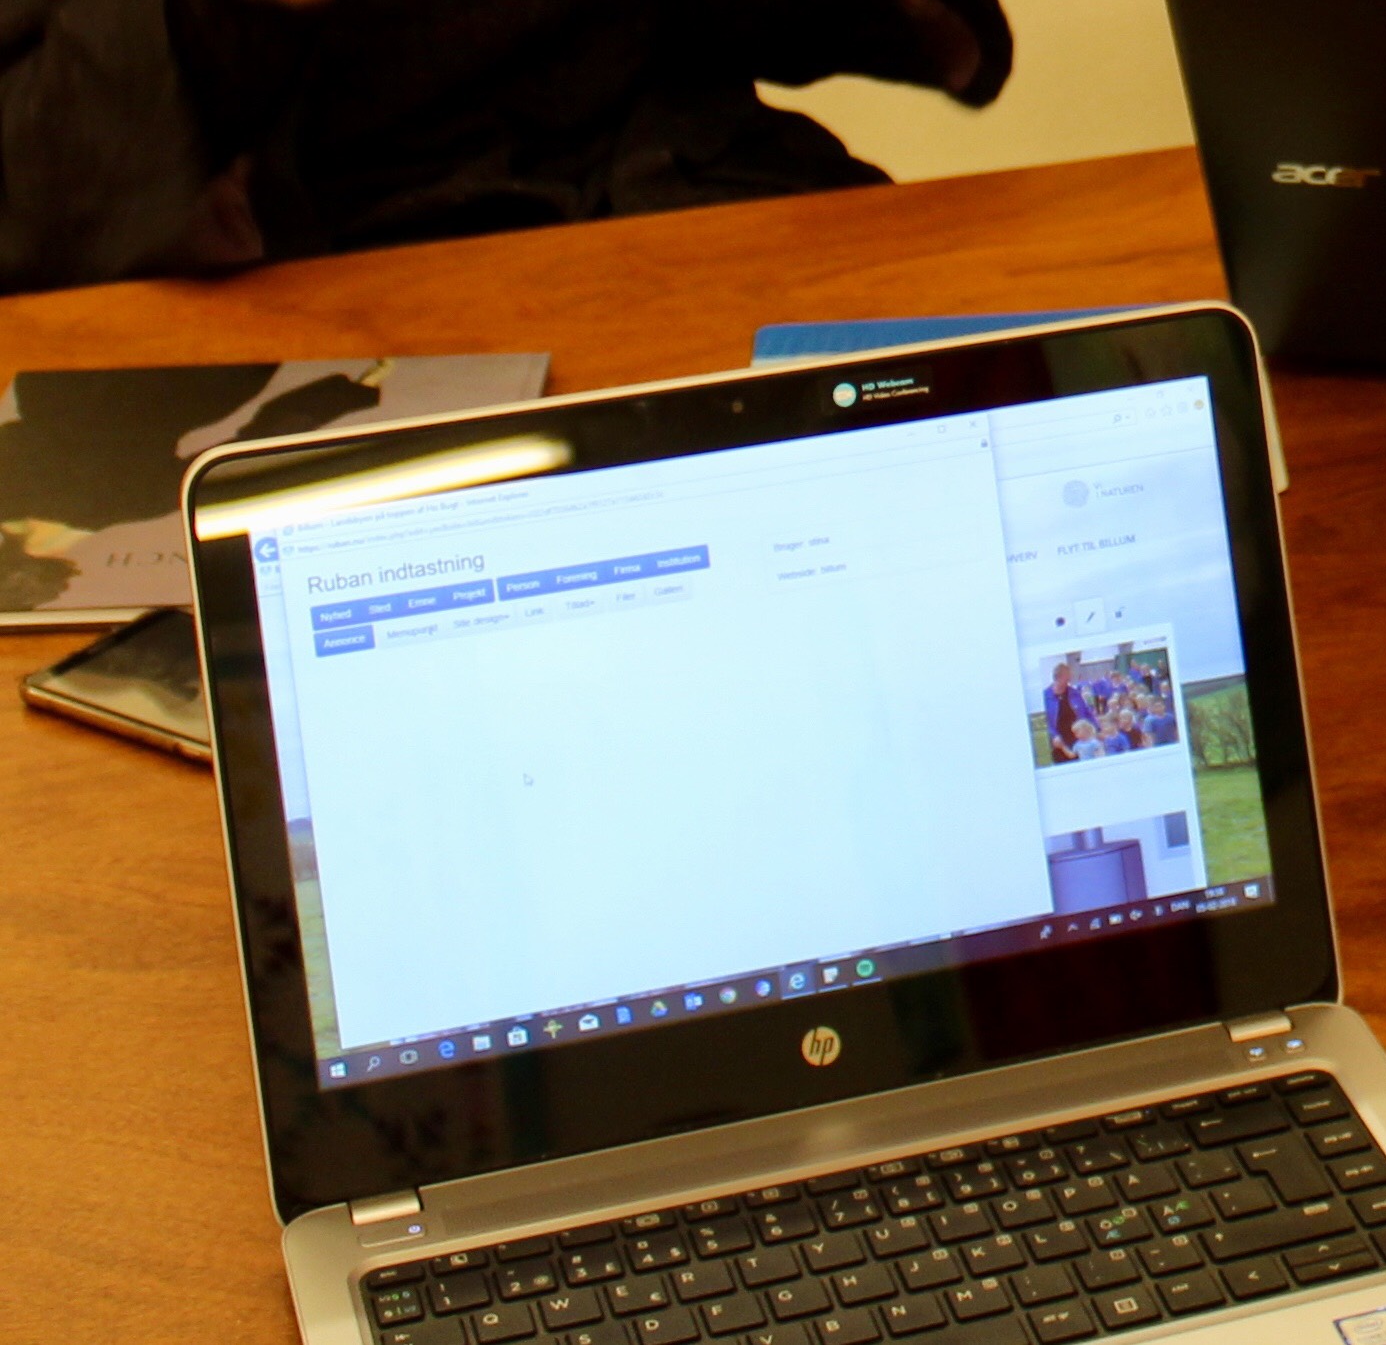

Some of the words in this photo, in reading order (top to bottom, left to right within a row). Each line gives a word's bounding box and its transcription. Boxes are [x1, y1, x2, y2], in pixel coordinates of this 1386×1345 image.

[1271, 164, 1381, 187] acer
[307, 571, 373, 594] Ruban
[379, 554, 485, 583] indtastning
[320, 608, 352, 623] Nyhed
[506, 579, 540, 593] Person
[524, 606, 545, 618] Link
[549, 1297, 571, 1310] W
